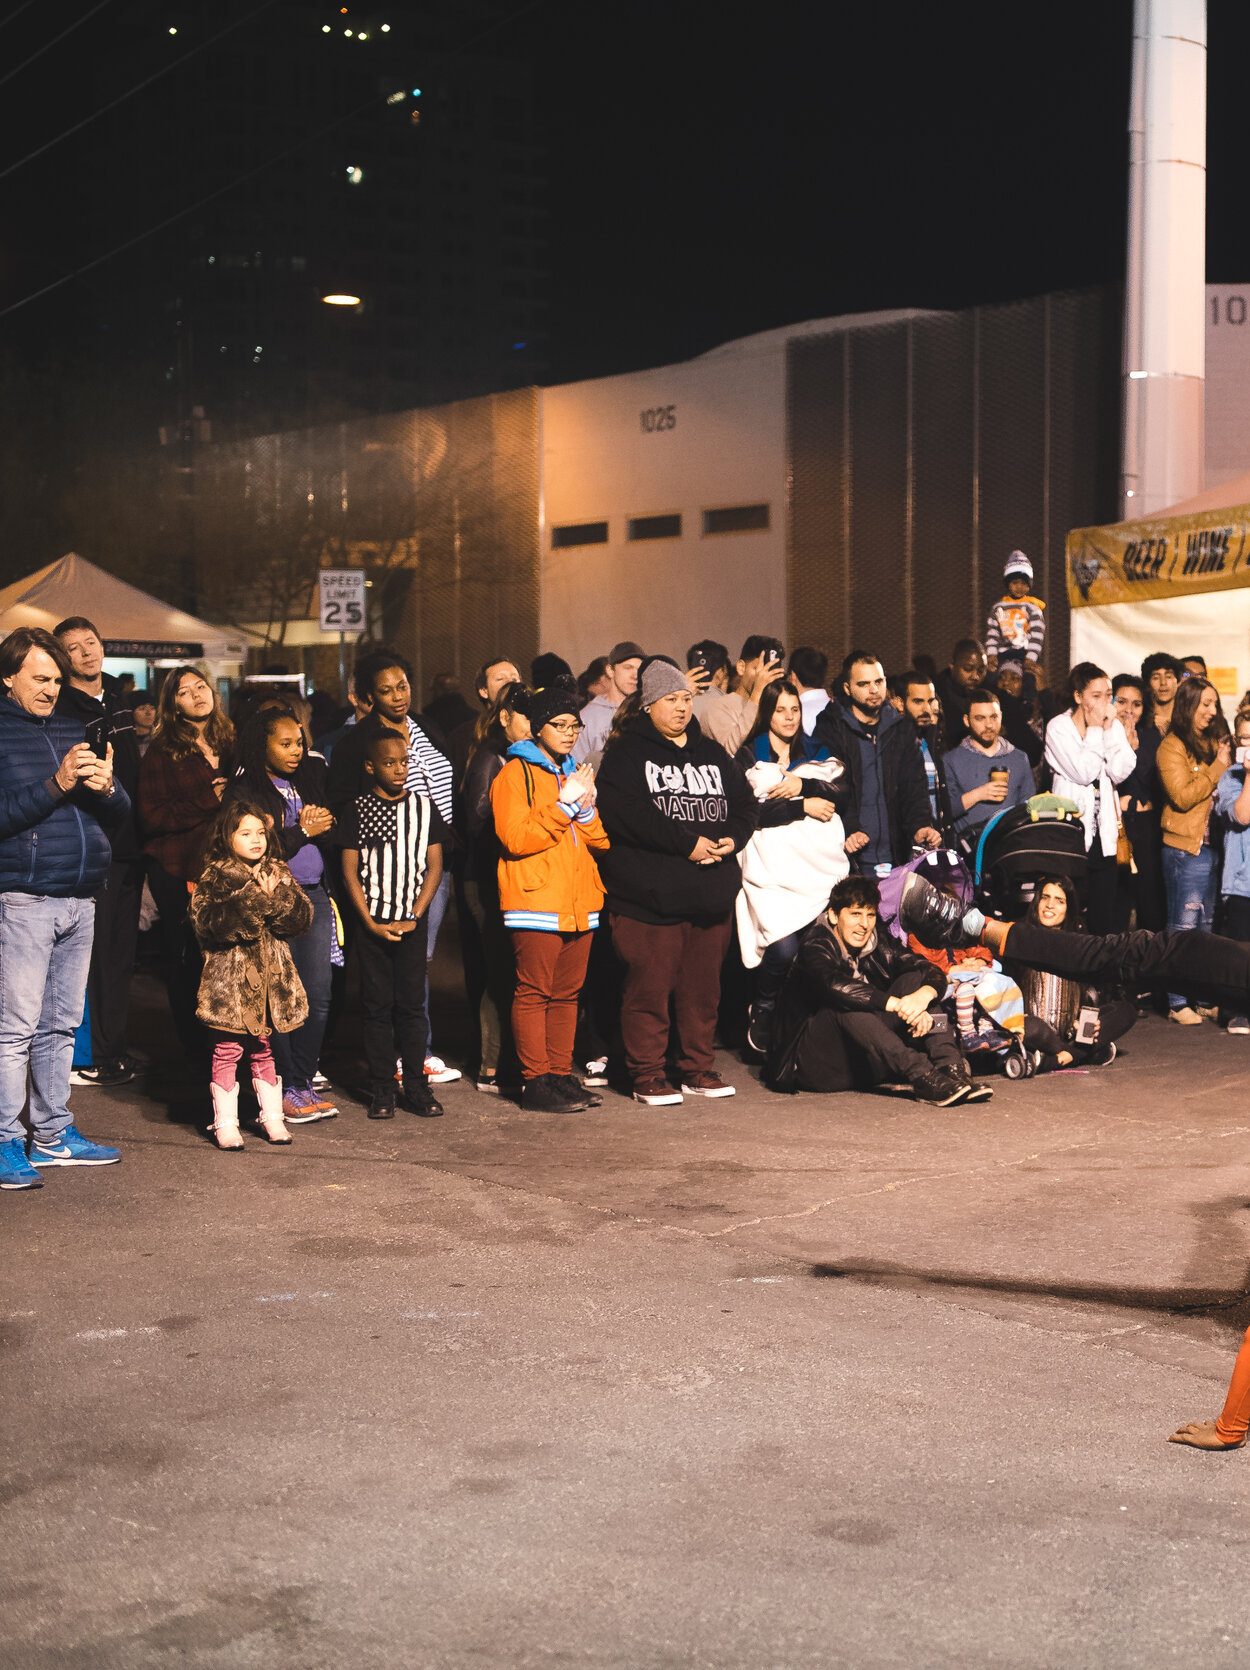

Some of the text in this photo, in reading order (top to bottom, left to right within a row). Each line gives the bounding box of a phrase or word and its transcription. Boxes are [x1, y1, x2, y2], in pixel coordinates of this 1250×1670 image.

[639, 404, 677, 432] 1025
[1123, 538, 1167, 582] BEER
[322, 575, 361, 587] SPEED
[327, 589, 356, 599] LIMIT
[325, 601, 363, 623] 25
